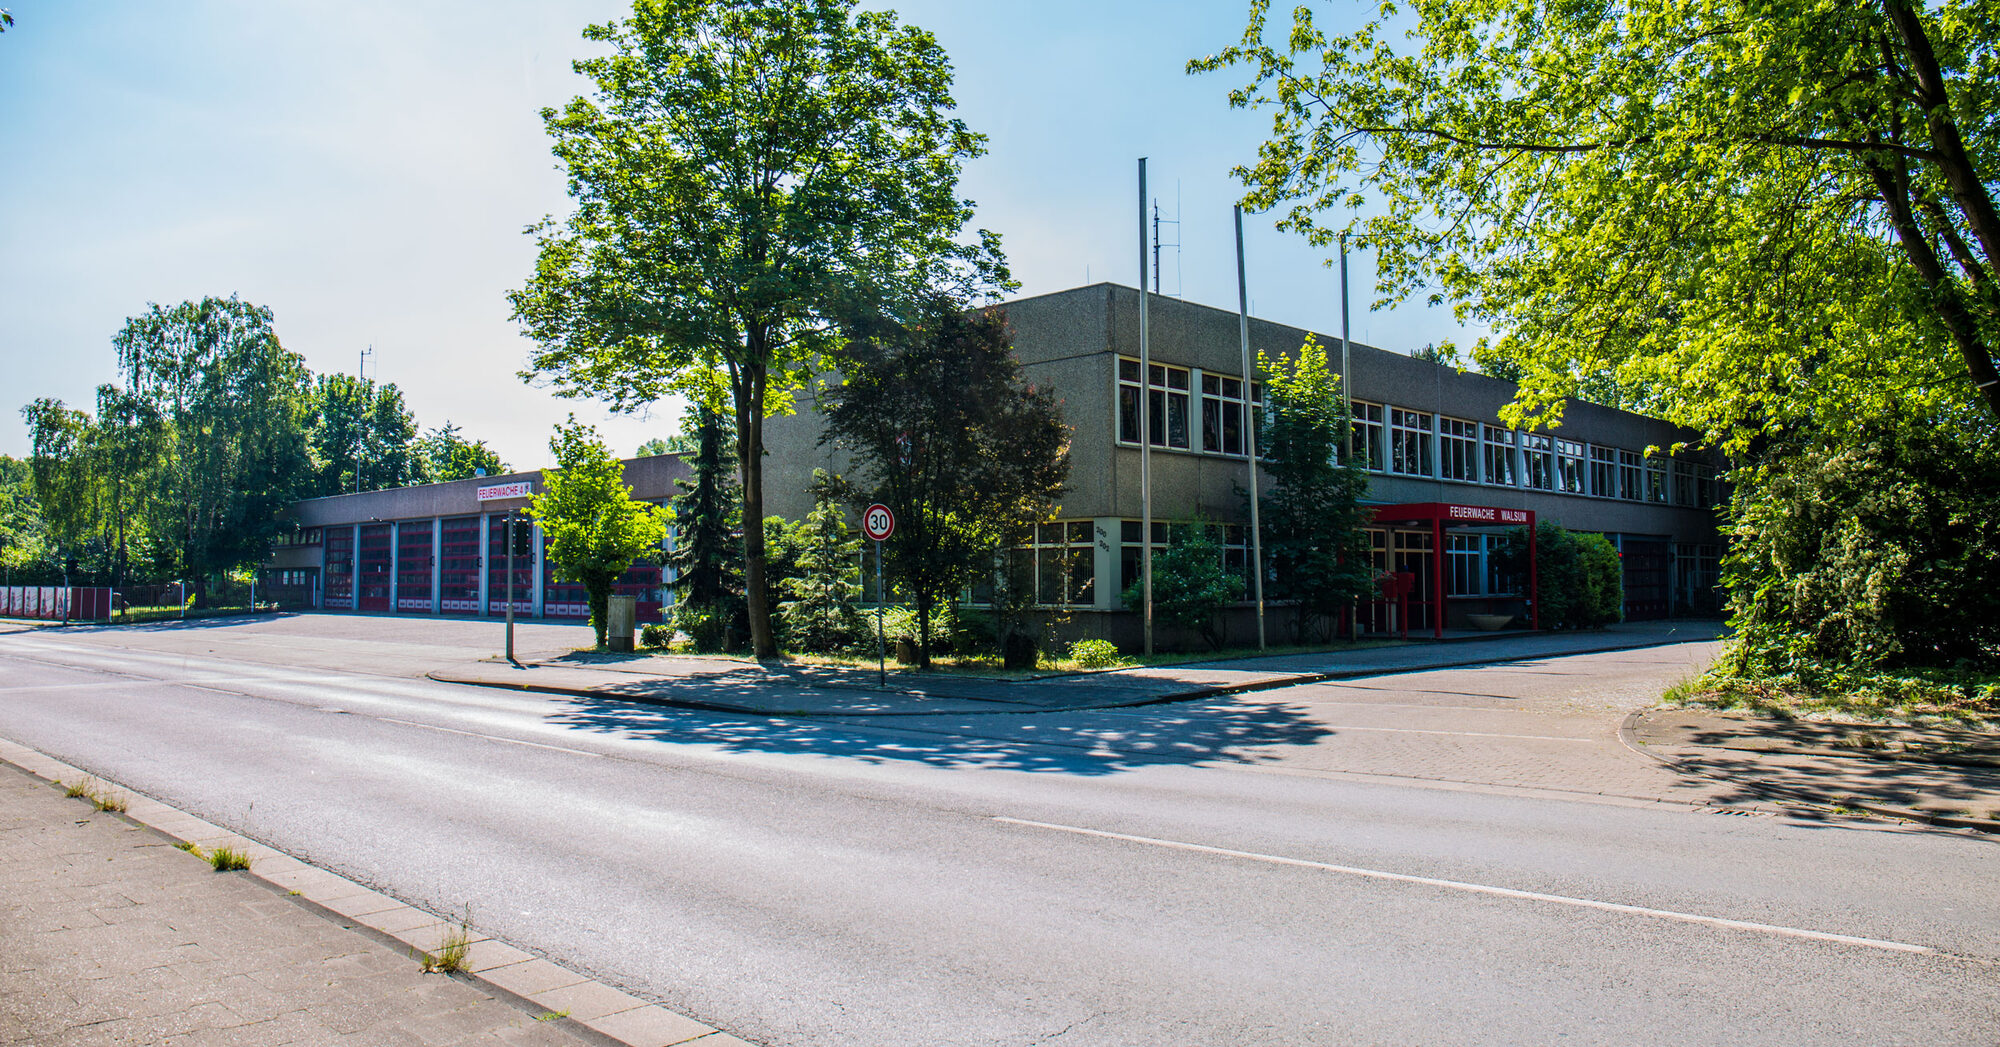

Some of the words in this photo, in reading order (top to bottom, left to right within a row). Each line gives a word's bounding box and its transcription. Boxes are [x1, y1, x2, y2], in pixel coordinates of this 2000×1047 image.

[479, 485, 518, 499] FEUERWACHE
[1449, 506, 1495, 520] FEUERWACHE
[1501, 510, 1527, 522] WALSUM
[870, 514, 888, 530] 30
[1096, 526, 1107, 538] 200
